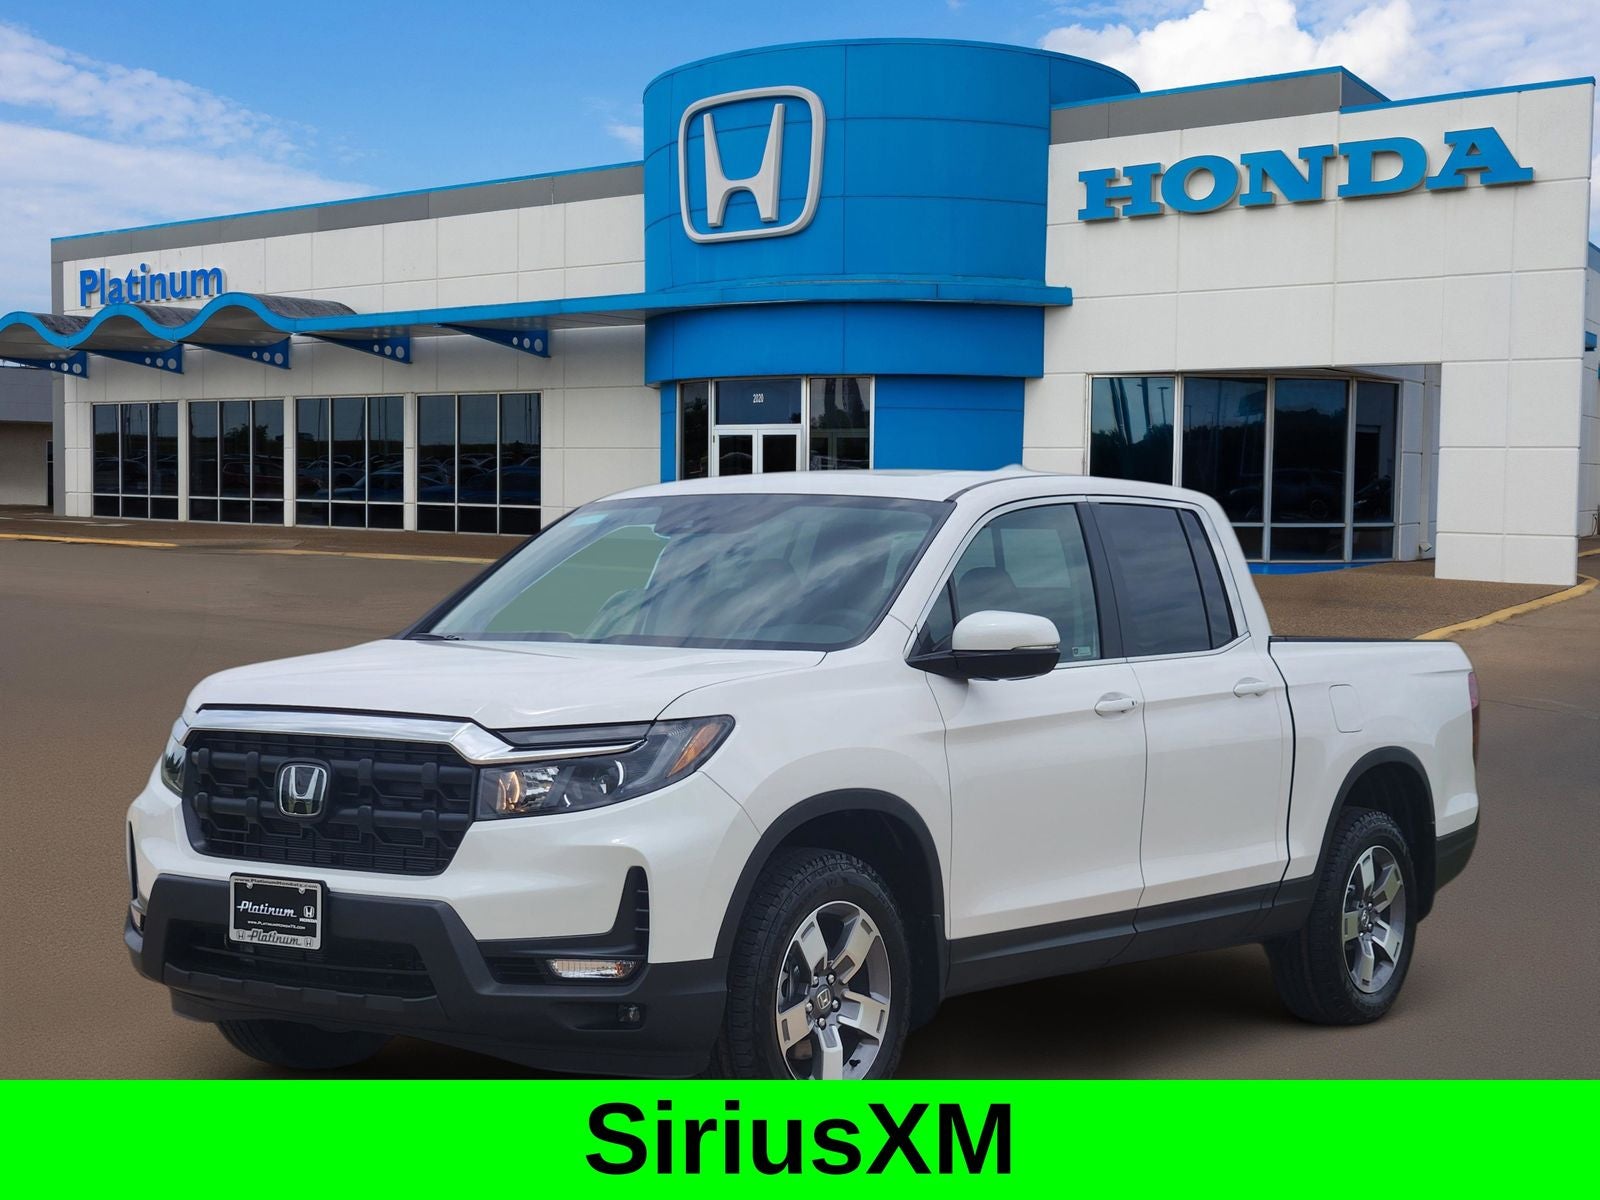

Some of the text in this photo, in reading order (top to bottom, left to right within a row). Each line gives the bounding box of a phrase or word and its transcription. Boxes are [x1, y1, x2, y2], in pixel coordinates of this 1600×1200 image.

[1078, 126, 1534, 221] HONDA
[79, 262, 225, 307] Platinum
[236, 900, 297, 918] Platinum
[247, 929, 302, 946] Platinum
